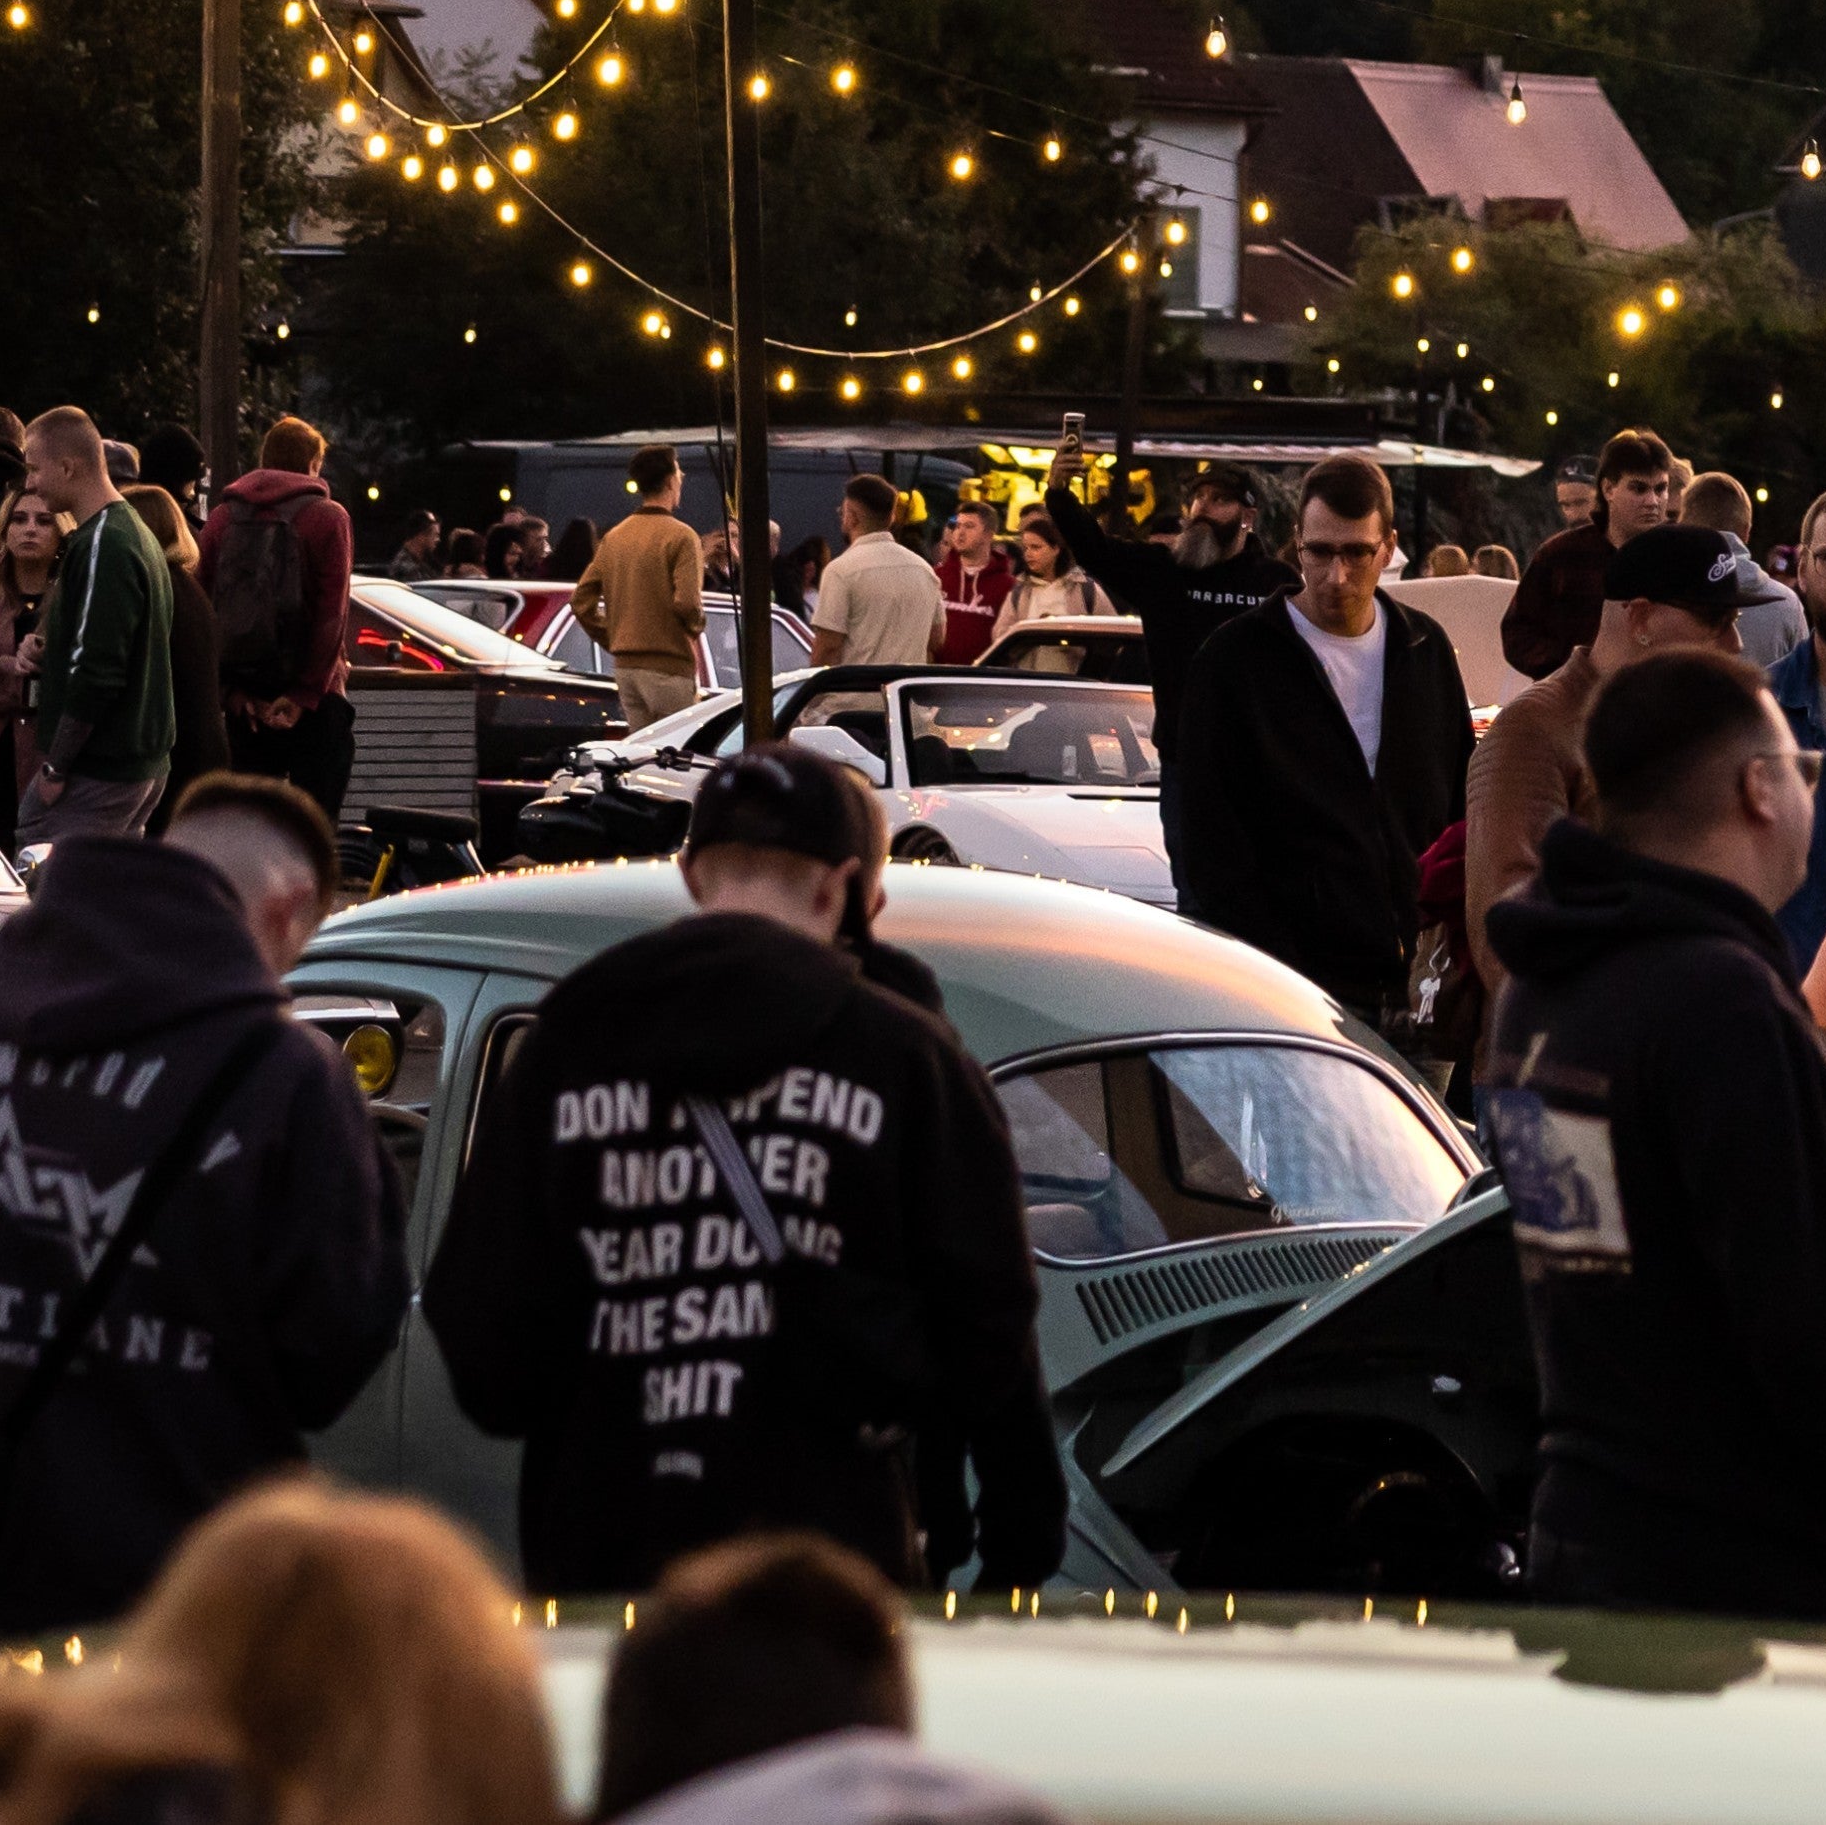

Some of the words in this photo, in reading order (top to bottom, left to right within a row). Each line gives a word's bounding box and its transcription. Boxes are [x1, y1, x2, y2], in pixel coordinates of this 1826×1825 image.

[601, 1132, 831, 1210] ANOTER
[579, 1223, 683, 1284] YEAR
[693, 1215, 843, 1271] DONG
